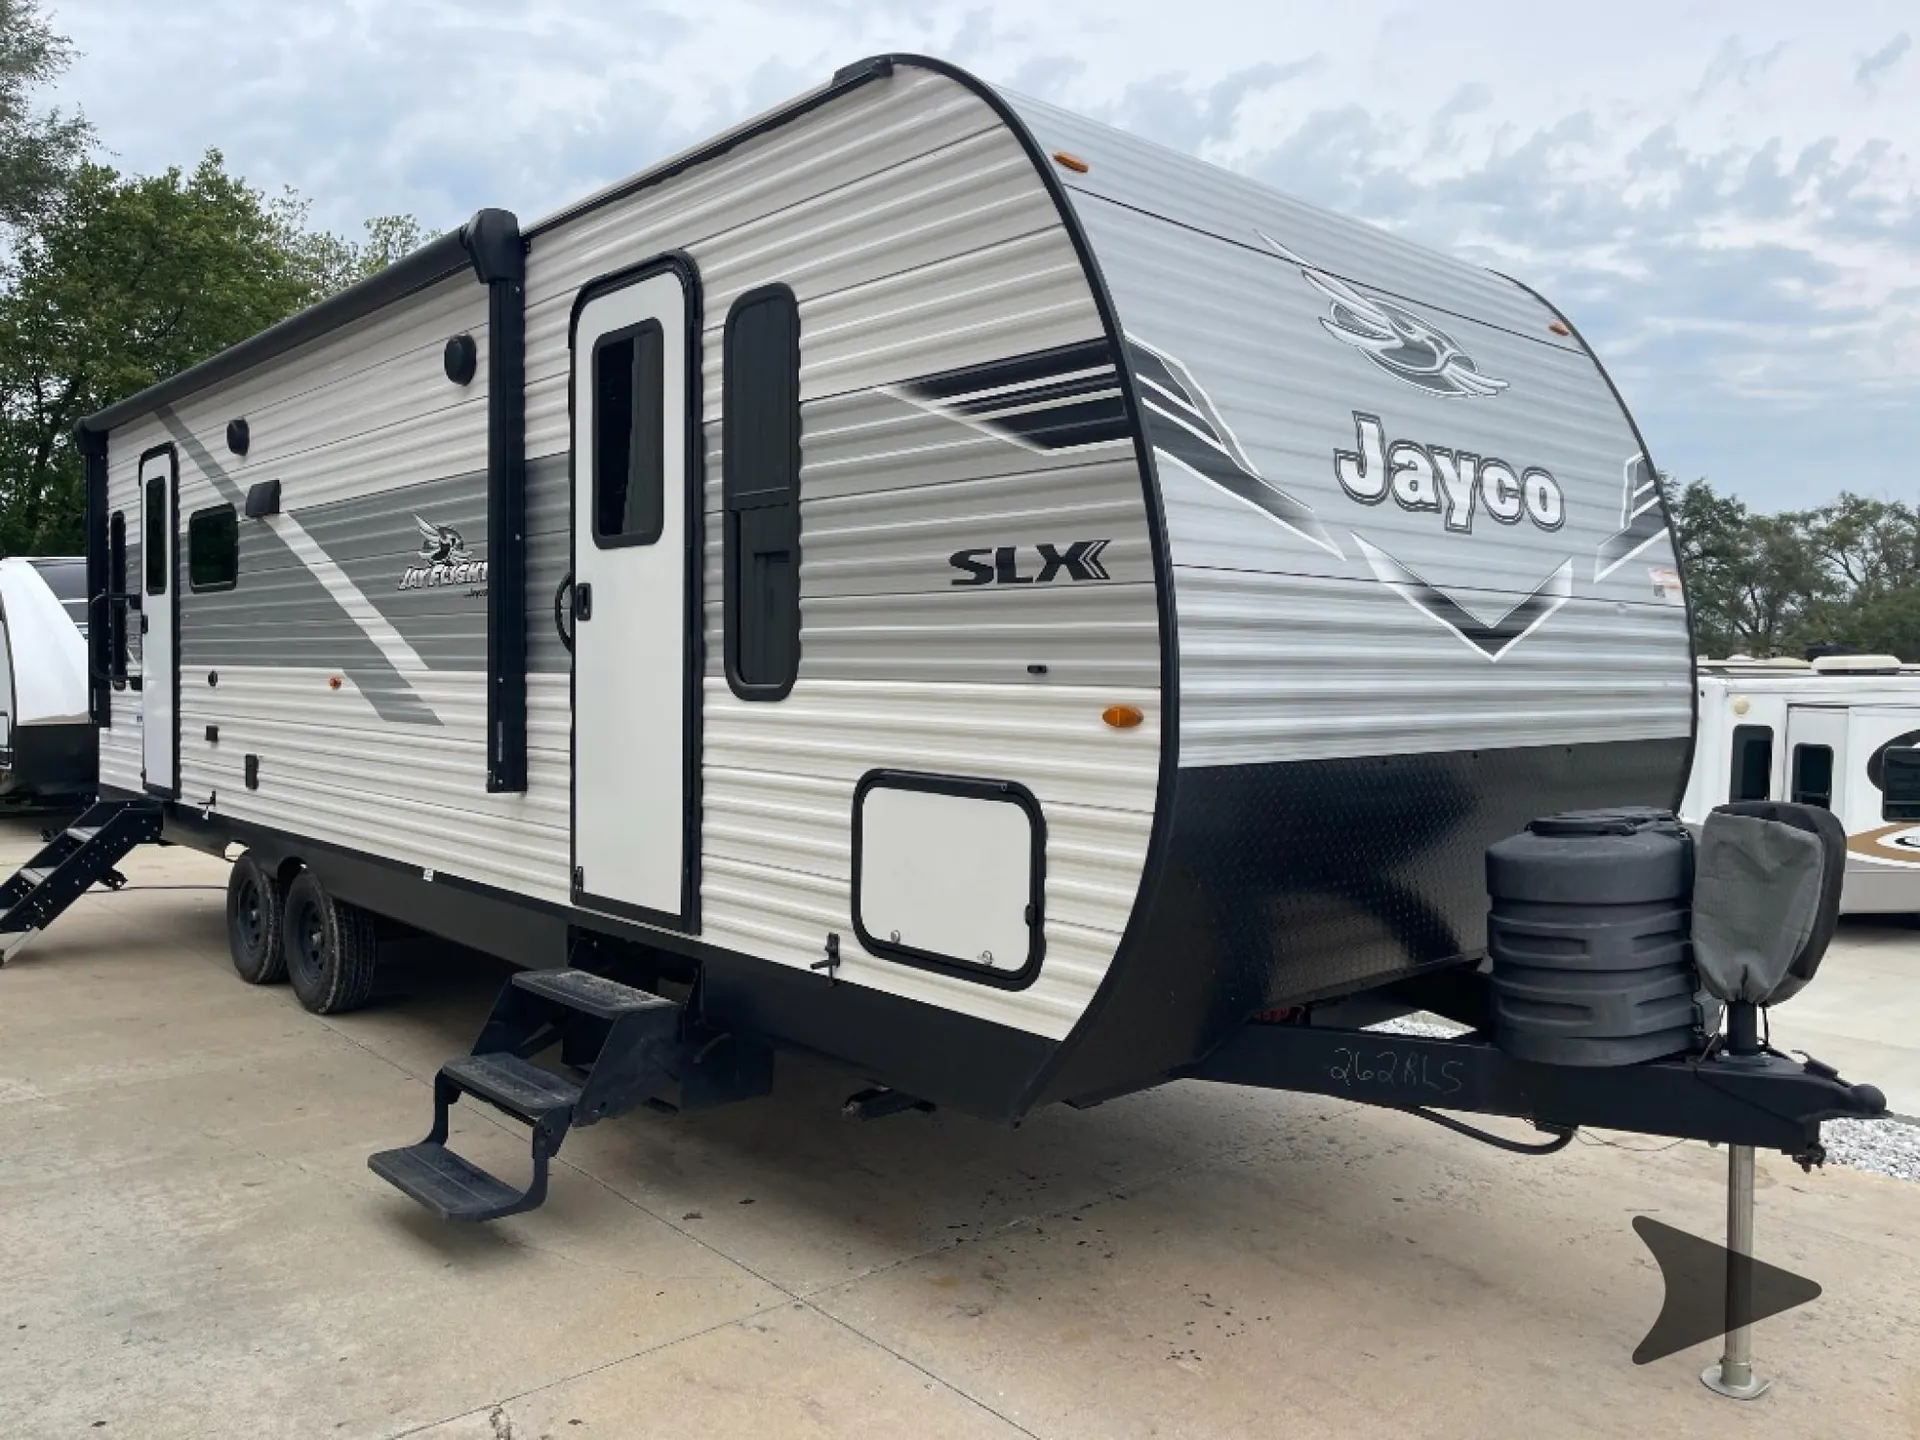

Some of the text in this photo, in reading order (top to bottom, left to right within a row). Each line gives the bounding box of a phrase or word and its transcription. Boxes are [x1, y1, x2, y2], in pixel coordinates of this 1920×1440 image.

[1333, 410, 1566, 534] Jayco
[398, 566, 432, 590] JAY
[948, 540, 1111, 585] SLX
